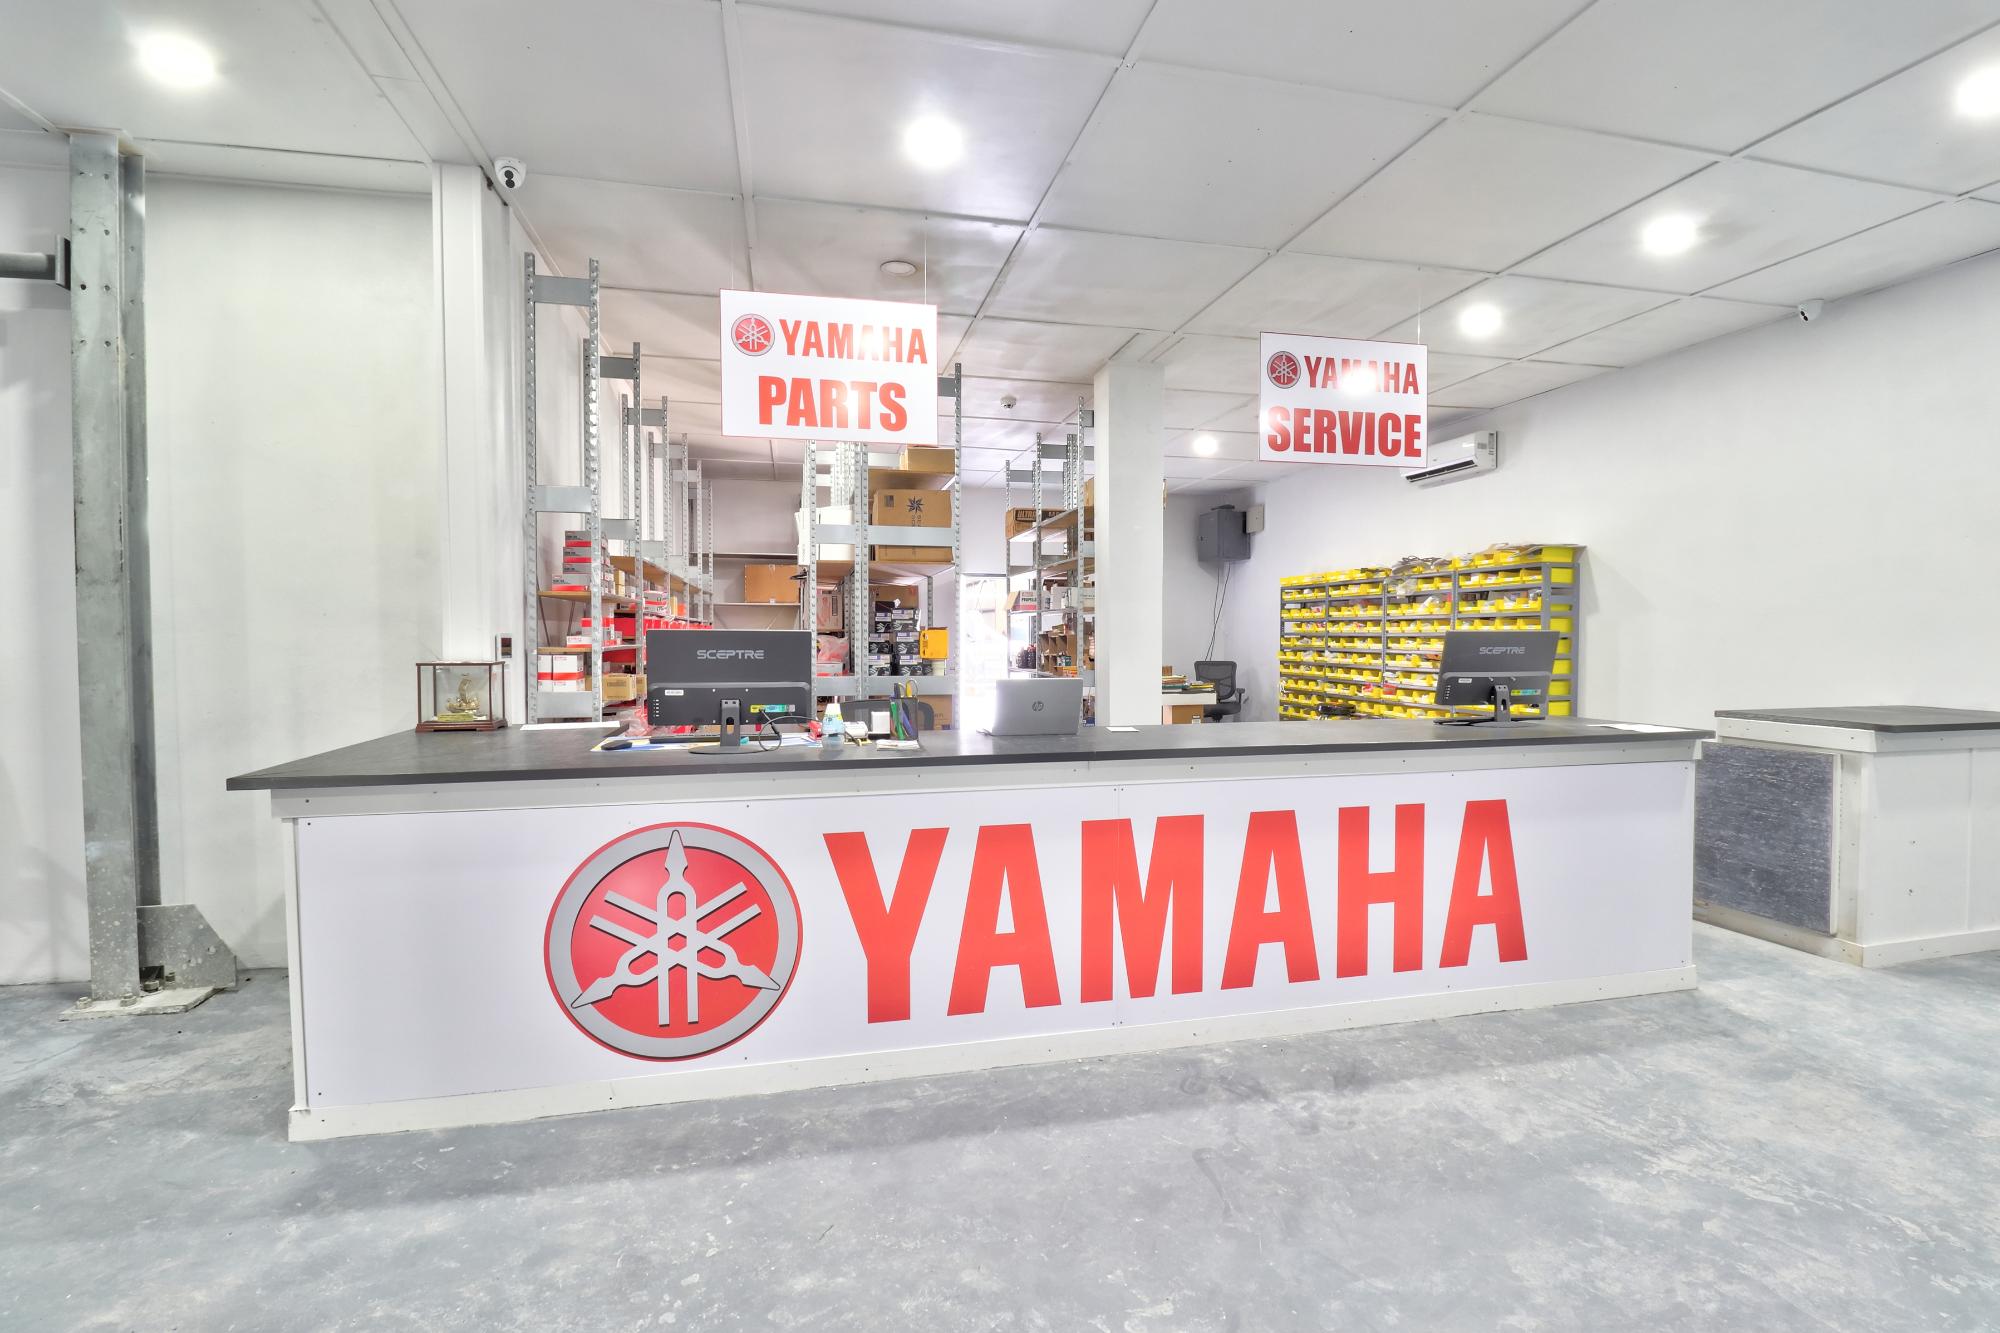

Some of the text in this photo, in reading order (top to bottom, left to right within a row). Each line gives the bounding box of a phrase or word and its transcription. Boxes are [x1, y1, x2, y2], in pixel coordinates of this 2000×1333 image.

[778, 318, 928, 365] YAMAHA
[1303, 355, 1420, 395] YAHA
[758, 375, 908, 432] PARTS
[1267, 405, 1422, 458] SERVICE
[696, 649, 765, 660] SCEPTRE
[1478, 646, 1526, 655] SCEPTRE
[822, 798, 1529, 1024] YAMAHA
